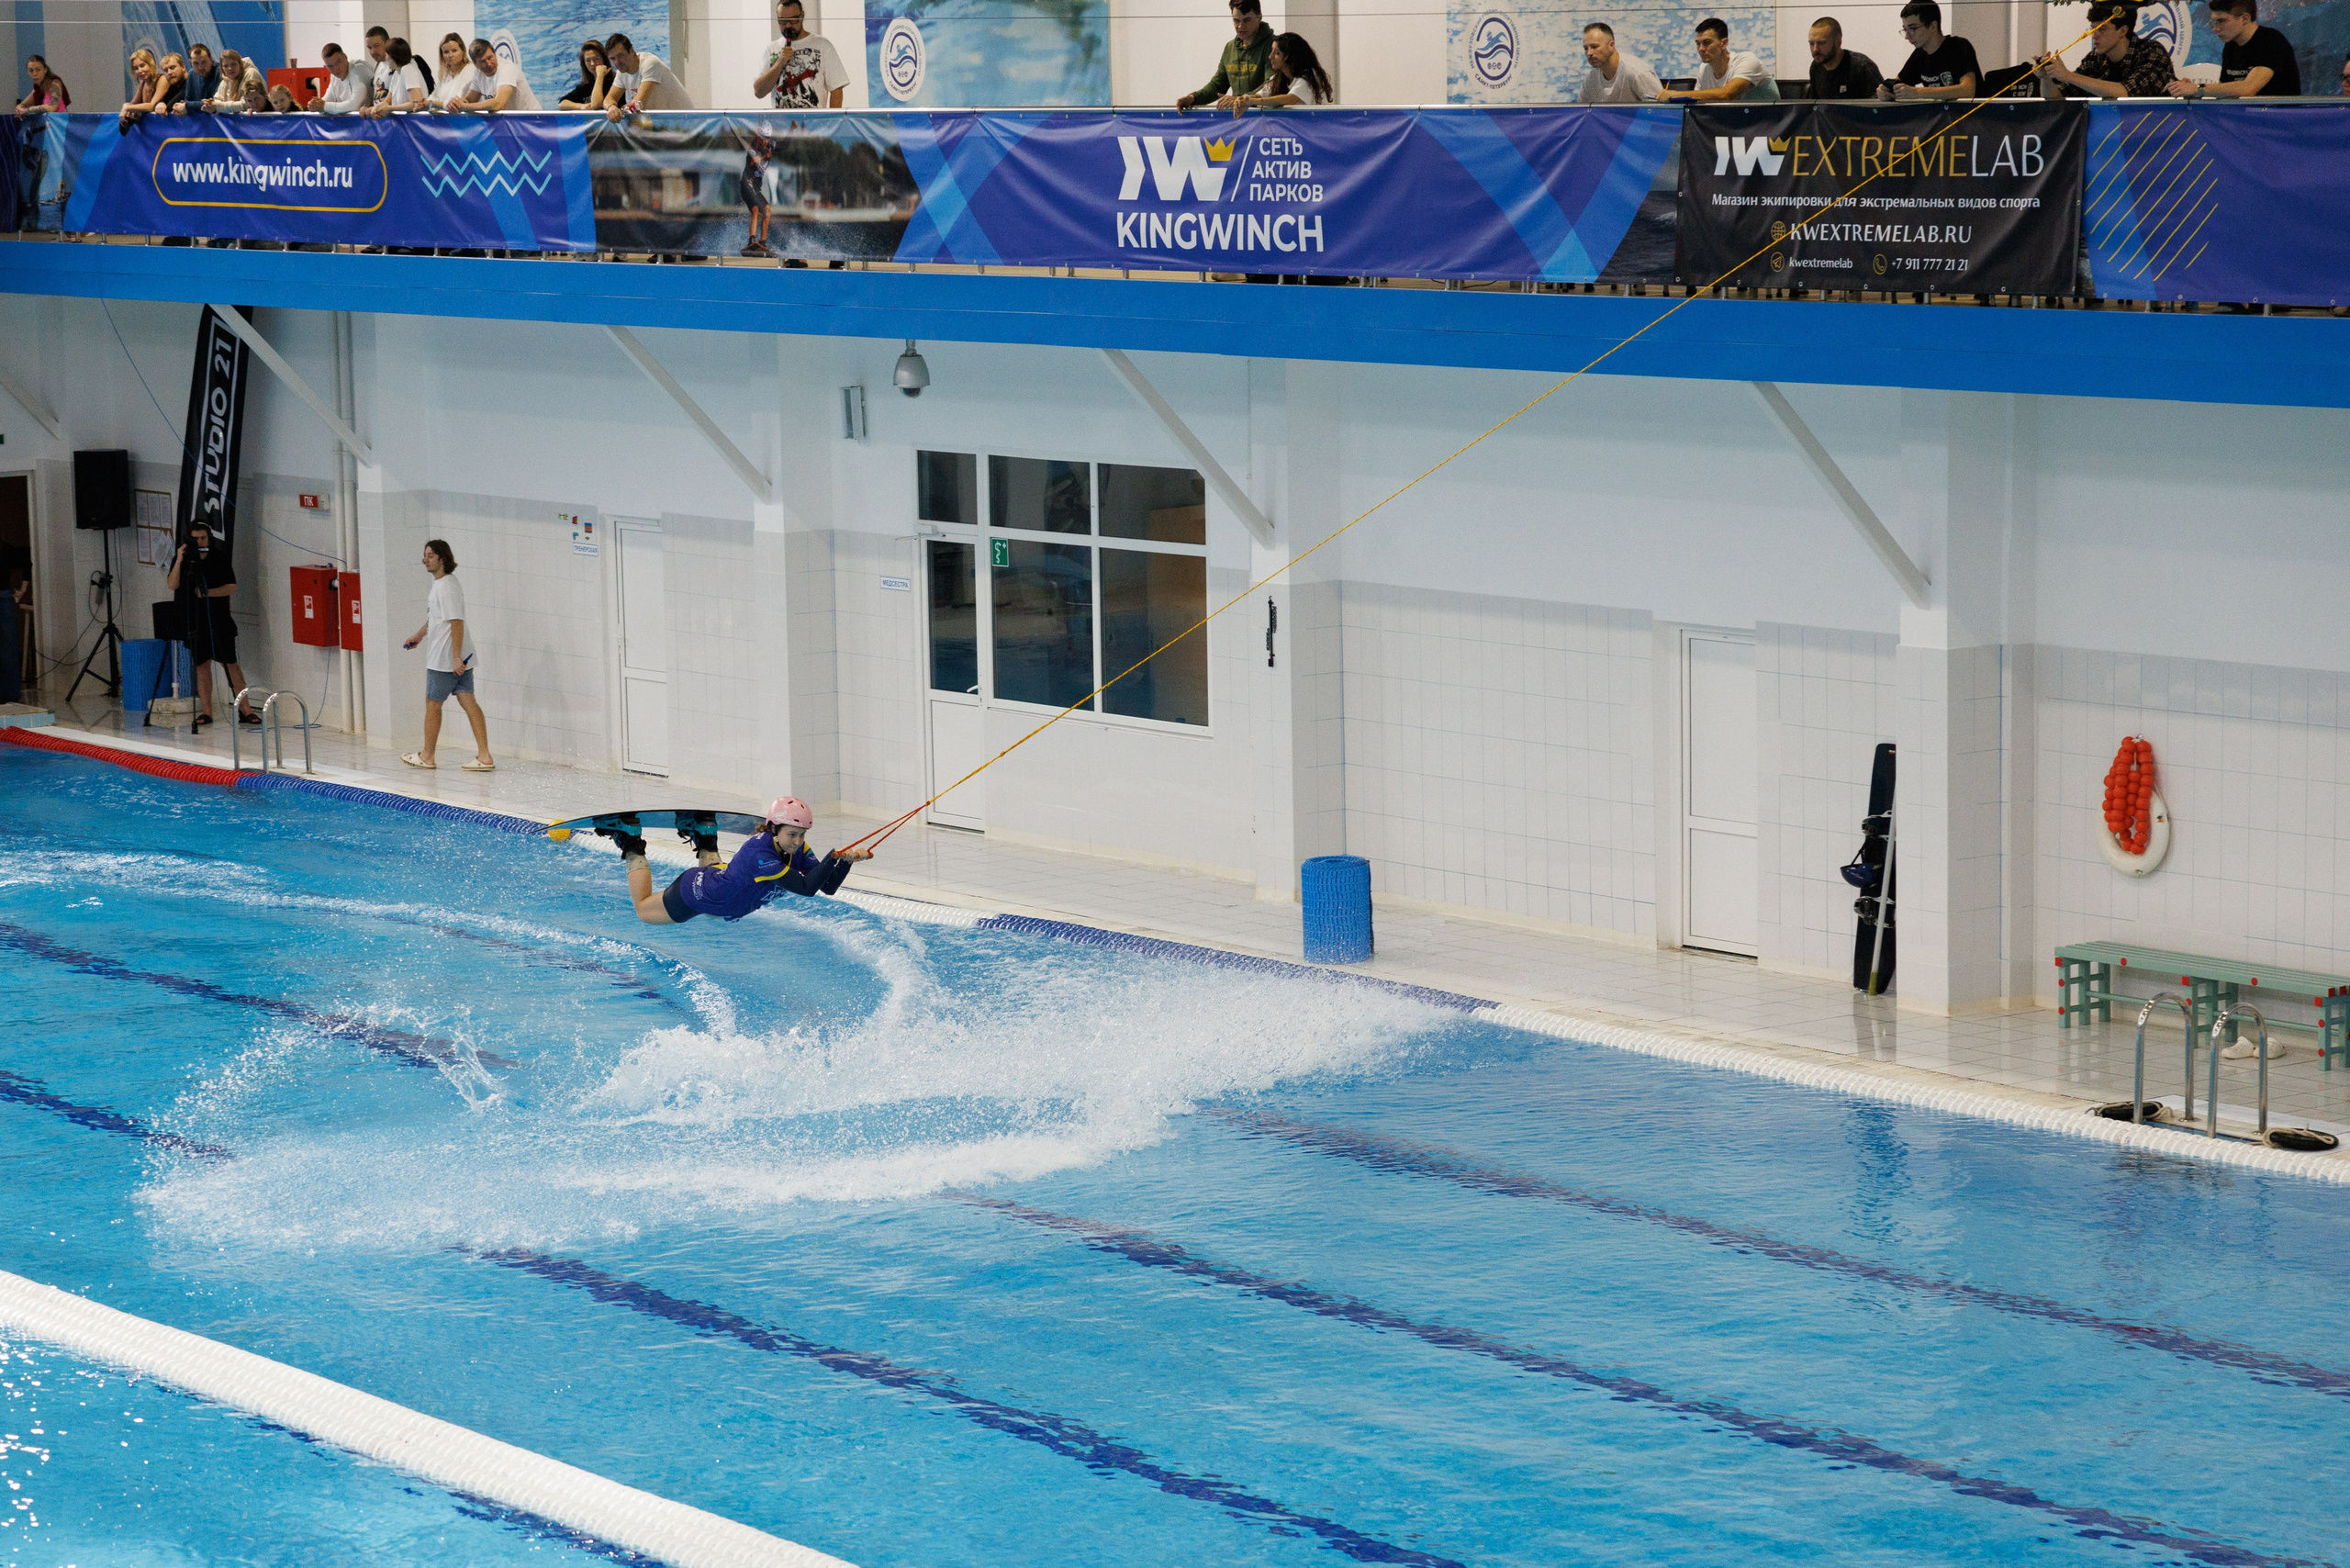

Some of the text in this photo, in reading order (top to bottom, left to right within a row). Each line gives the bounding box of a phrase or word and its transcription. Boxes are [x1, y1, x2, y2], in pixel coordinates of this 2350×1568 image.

[1259, 137, 1304, 156] СЕТЬ
[1793, 134, 2044, 177] EXTREMELAB
[173, 156, 352, 192] www.kingwinch.ru
[1251, 161, 1313, 179] АКТИВ
[1249, 184, 1324, 202] ПАРКОВ
[1712, 193, 2041, 211] Магазин экипировки для экстремальных видов спорта
[1116, 212, 1324, 252] KINGWINCH
[1790, 223, 1972, 243] KWEXTREMELAB.RU
[1789, 256, 1853, 269] kwextremelab
[1892, 258, 1968, 272] +7 911 777 21 21
[204, 337, 232, 514] STUDIO 21
[304, 496, 314, 507] ПК
[882, 579, 909, 588] МЕДСЕСТРА
